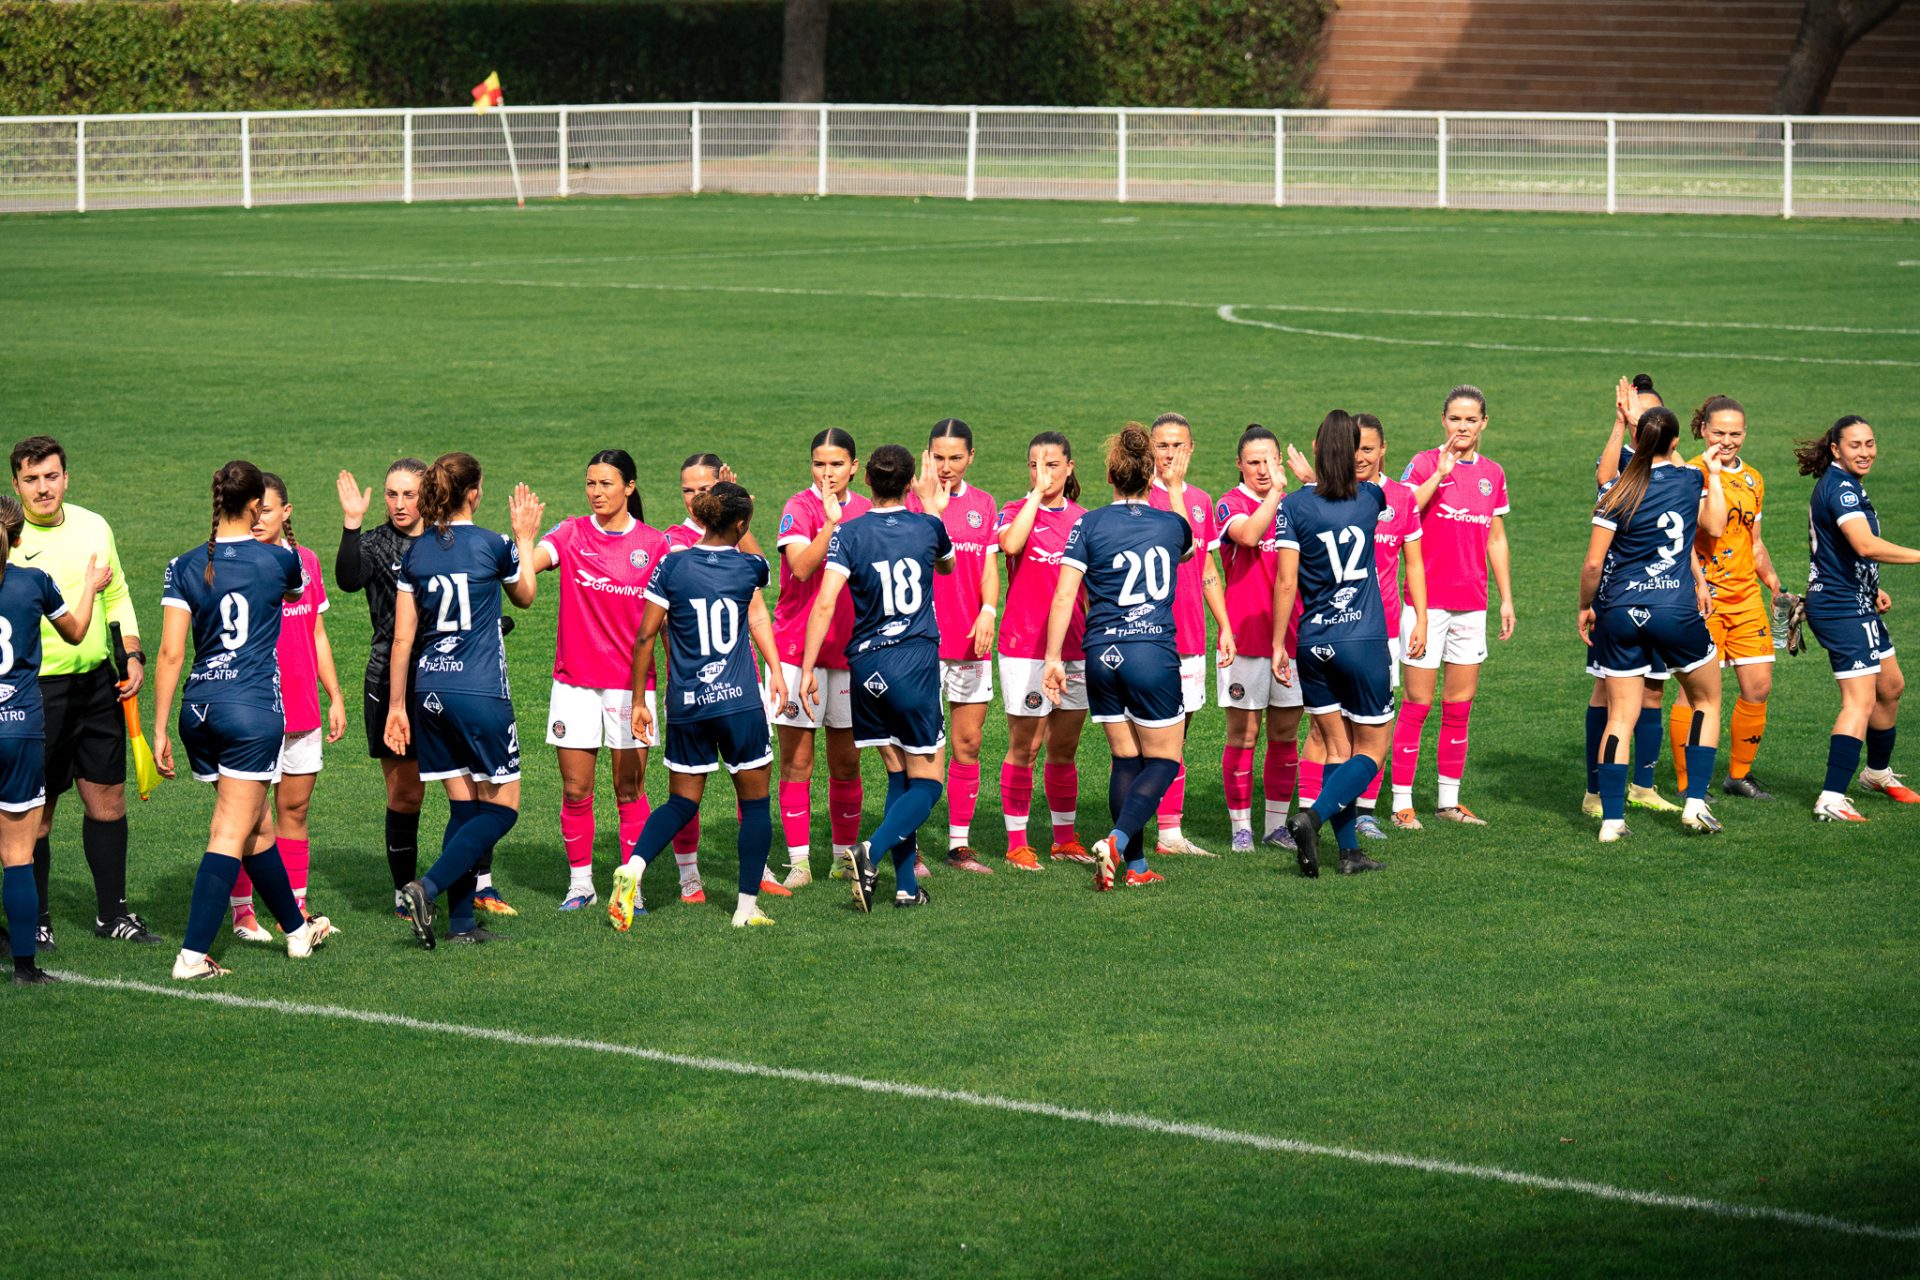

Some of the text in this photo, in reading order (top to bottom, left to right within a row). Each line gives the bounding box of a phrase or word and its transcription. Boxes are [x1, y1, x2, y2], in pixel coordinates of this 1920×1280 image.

[1316, 526, 1369, 584] 12
[1657, 511, 1684, 558] 3
[428, 573, 471, 631] 21
[872, 558, 922, 616] 18
[1113, 546, 1171, 607] 20
[220, 592, 249, 650] 9
[689, 598, 739, 656] 10
[1862, 620, 1880, 648] 19
[697, 686, 743, 706] THEATRO
